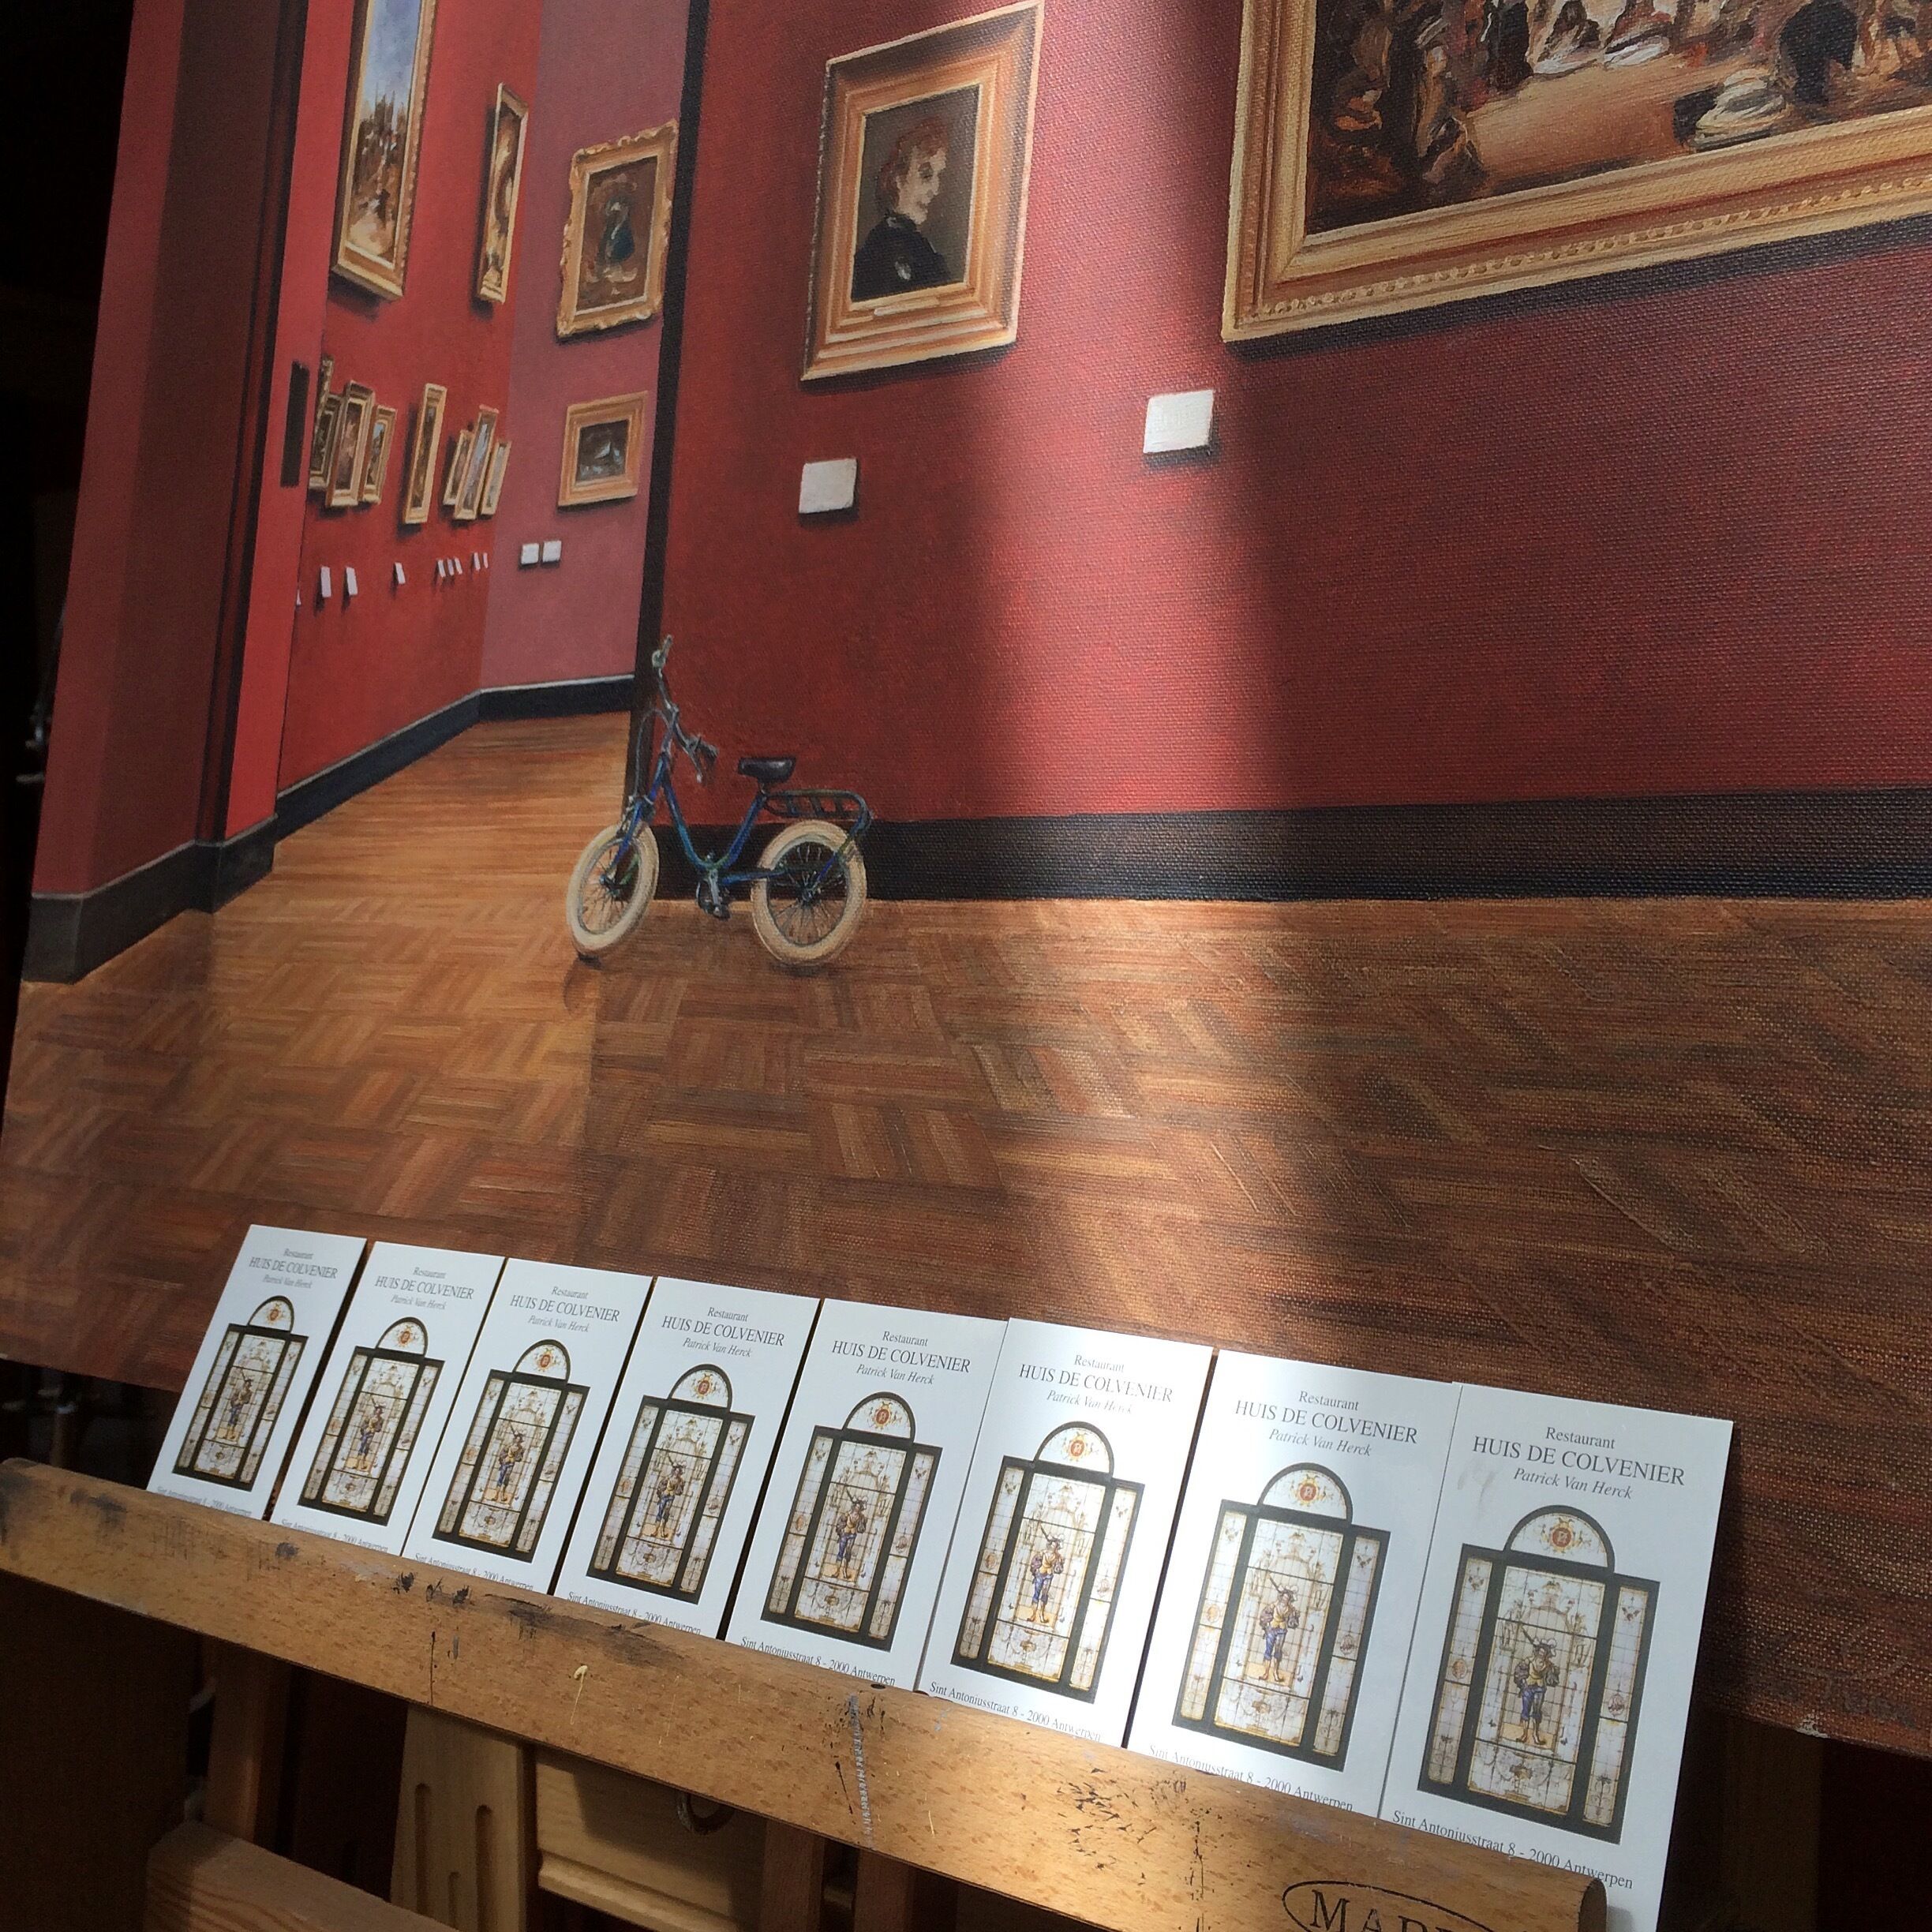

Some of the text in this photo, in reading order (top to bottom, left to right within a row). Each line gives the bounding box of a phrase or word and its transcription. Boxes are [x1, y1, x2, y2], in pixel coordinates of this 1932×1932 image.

[249, 1257, 338, 1279] HUIS DE COLVENIER
[414, 1267, 447, 1279] Restaurant
[375, 1275, 474, 1299] HUIS DE COLVENIER
[552, 1286, 589, 1299] Restaurant
[510, 1295, 620, 1322] HUIS DE COLVENIER
[707, 1307, 748, 1322] Restaurant
[528, 1315, 590, 1332] Patrick Van Herck
[661, 1316, 784, 1346] HUIS DE COLVENIER
[683, 1338, 753, 1357] Patrick Van Herck
[882, 1331, 928, 1346] Restaurant
[832, 1341, 971, 1372] HUIS DE COLVENIER
[1074, 1354, 1125, 1373] Restaurant
[856, 1364, 934, 1384] Patrick Van Herck
[1019, 1365, 1173, 1402] HUIS DE COLVENIER
[1046, 1390, 1131, 1413] Patrick Van Herck
[1298, 1391, 1359, 1411] Restaurant
[1235, 1400, 1418, 1443] HUIS DE COLVENIER
[1269, 1428, 1372, 1456] Patrick Van Herck
[1545, 1427, 1616, 1450] Restaurant
[1473, 1436, 1685, 1485] HUIS DE COLVENIER
[1513, 1468, 1633, 1500] Patrick Van Herck
[567, 1591, 582, 1603] Sint
[632, 1608, 638, 1617] 8
[645, 1612, 662, 1624] 2000
[741, 1636, 756, 1649] Sint
[758, 1642, 814, 1665] Antoniusstraat
[815, 1656, 821, 1665] 8
[829, 1659, 849, 1673] 2000
[851, 1666, 896, 1686] Antwerpen
[930, 1681, 947, 1696] Sint
[949, 1687, 1011, 1714] Antoniusstraat
[1012, 1705, 1018, 1717] 8
[1027, 1710, 1050, 1725] 2000
[1052, 1717, 1101, 1742] Antwerpen
[1148, 1745, 1168, 1757] Sint
[1172, 1751, 1245, 1783] Antoniusstraat
[1246, 1771, 1254, 1784] 8
[1264, 1777, 1291, 1794] 2000
[1294, 1785, 1353, 1811] Antwerpen
[1392, 1810, 1416, 1829] Sint
[1419, 1818, 1503, 1854] Antoniusstraat
[1507, 1843, 1517, 1855] 8
[1529, 1848, 1560, 1868] 2000
[1563, 1859, 1633, 1889] Antwerpen
